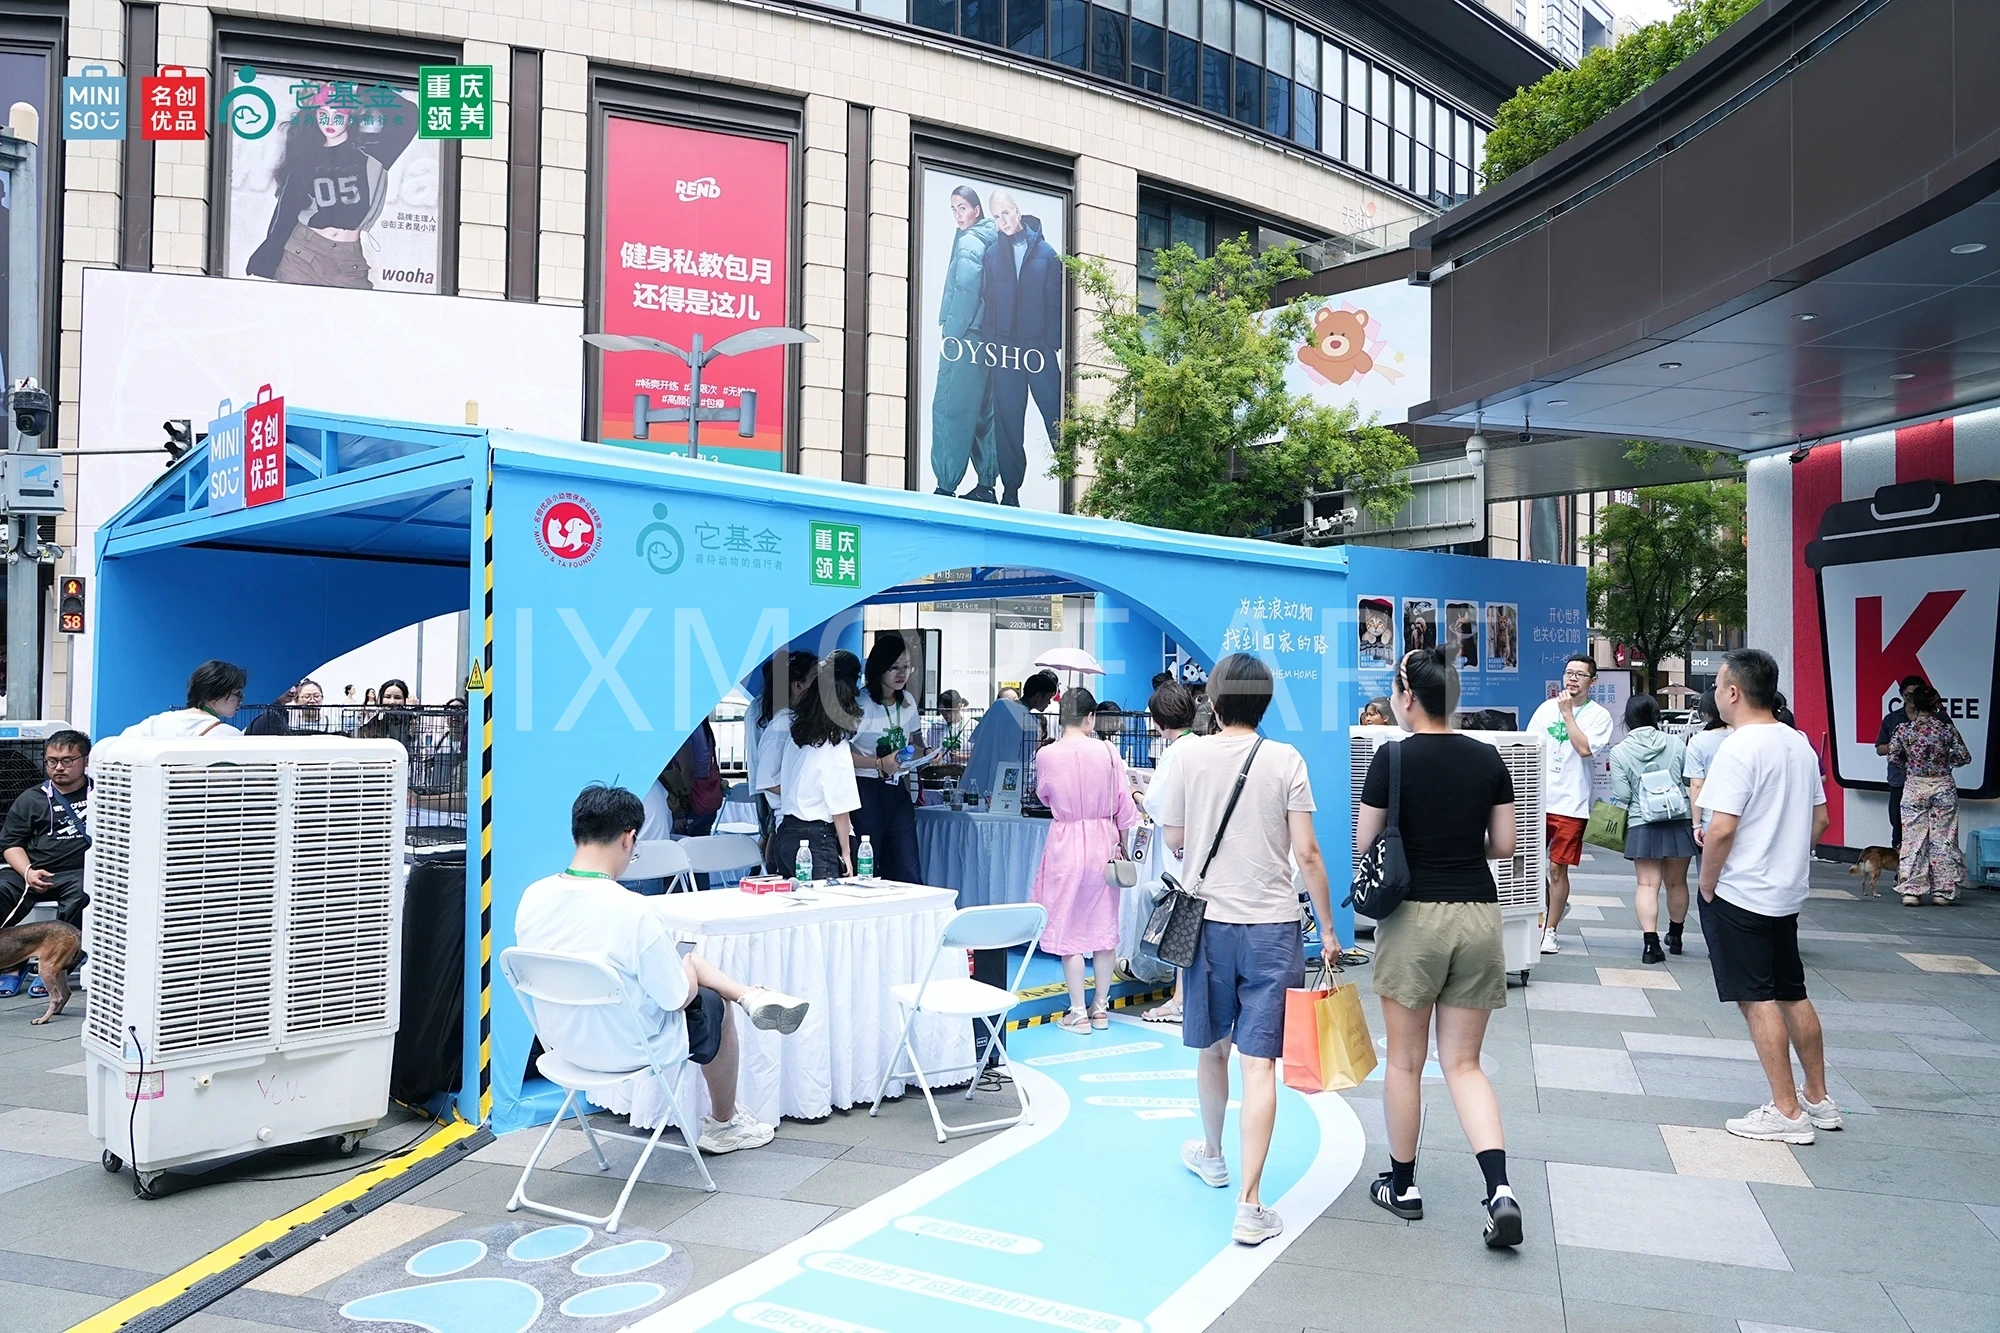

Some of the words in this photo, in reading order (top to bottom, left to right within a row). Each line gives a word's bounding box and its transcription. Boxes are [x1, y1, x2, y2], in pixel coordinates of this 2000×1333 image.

[314, 176, 361, 207] 05
[675, 178, 721, 201] REND
[397, 212, 437, 224] 品牌主理人
[620, 241, 772, 285] 健身私教包月
[382, 268, 434, 285] wooha
[632, 282, 761, 321] 还得是这儿
[940, 336, 1045, 374] OYSHO
[211, 427, 240, 462] MINI
[250, 413, 279, 452] 名创
[250, 453, 279, 492] 优品
[695, 521, 782, 554] 它基金
[815, 529, 855, 553] 重庆
[815, 556, 856, 581] 领养
[63, 615, 81, 629] 38
[1240, 596, 1313, 622] 为流浪动物
[1549, 607, 1580, 625] 开心世界
[1222, 627, 1329, 655] 找到回家的路
[1533, 626, 1580, 644] 也关心它们的
[1271, 668, 1292, 679] HEM
[1293, 669, 1318, 680] HOME
[1691, 657, 1709, 666] and
[1855, 589, 1967, 744] K
